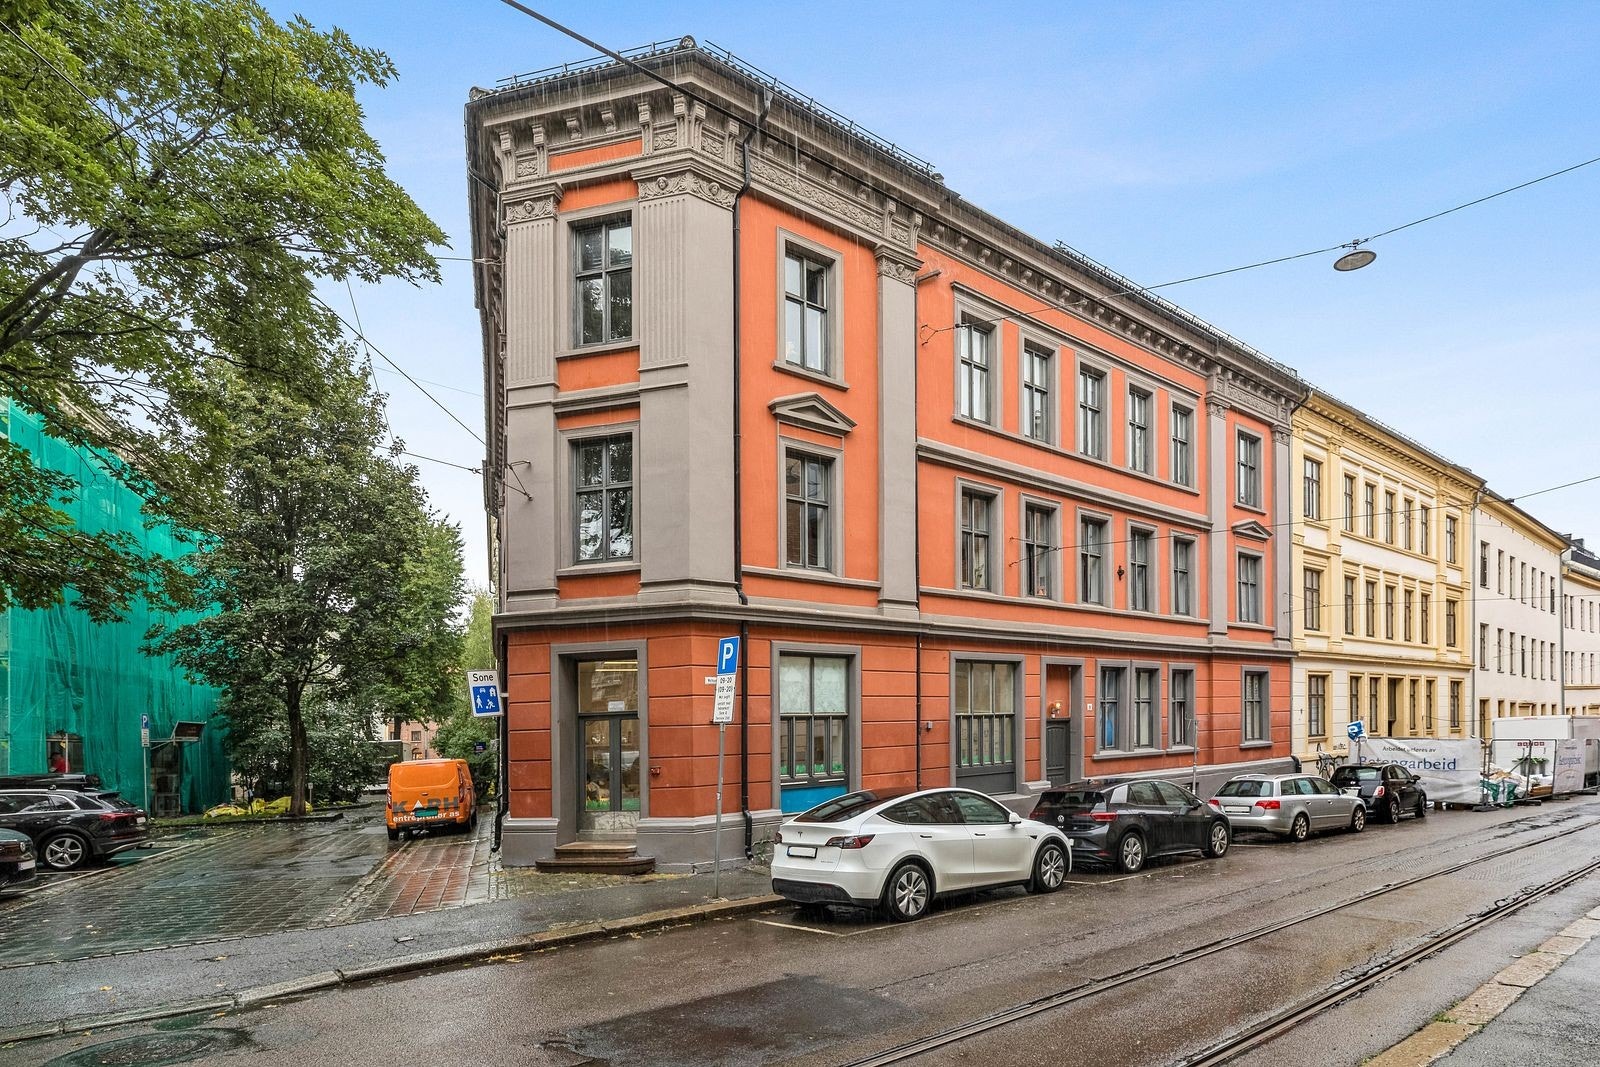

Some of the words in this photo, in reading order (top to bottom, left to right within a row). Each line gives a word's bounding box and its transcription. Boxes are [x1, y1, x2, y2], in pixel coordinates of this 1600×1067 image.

[722, 642, 734, 670] P
[472, 673, 494, 682] Sone
[142, 715, 148, 728] P
